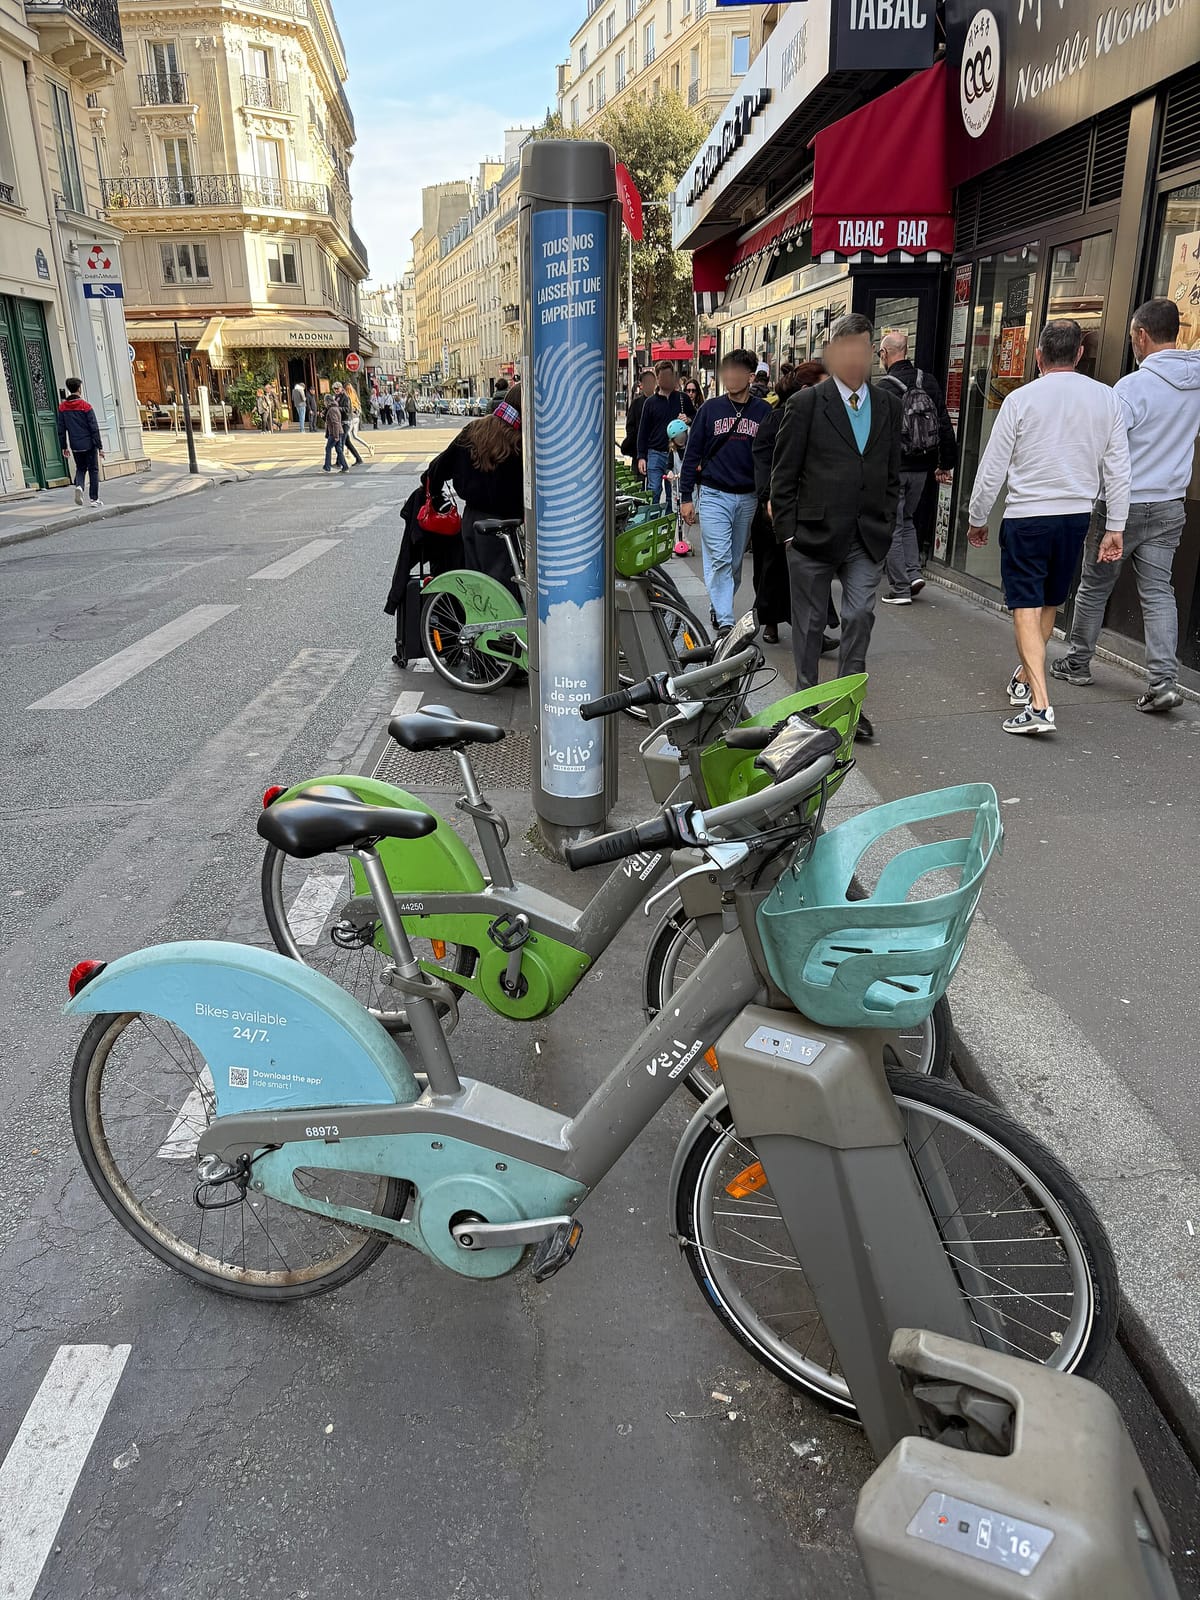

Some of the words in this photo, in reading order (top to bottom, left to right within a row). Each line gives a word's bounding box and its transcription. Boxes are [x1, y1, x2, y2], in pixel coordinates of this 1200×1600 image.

[848, 0, 927, 30] TABAC
[1014, 30, 1090, 109] Nouille
[623, 184, 636, 220] TABAC
[838, 220, 885, 247] TABAC
[897, 220, 929, 247] BAR
[542, 237, 569, 258] TOUS
[572, 233, 595, 251] NOS
[546, 256, 590, 279] TRAJETS
[537, 281, 581, 305] LAISSENT
[583, 276, 601, 294] UNE
[541, 299, 597, 326] EMPREINTE
[289, 332, 334, 341] MADONNA
[555, 676, 587, 688] Libre
[550, 688, 565, 701] de
[568, 692, 591, 701] son
[544, 703, 580, 717] empre
[401, 902, 424, 911] 44250
[195, 1002, 229, 1018] Bikes
[232, 1010, 287, 1026] available
[232, 1026, 270, 1043] 24/7.
[253, 1070, 291, 1081] Download
[292, 1074, 305, 1082] the
[253, 1080, 267, 1088] ride
[305, 1125, 339, 1137] 68973
[1009, 1535, 1032, 1558] 16
